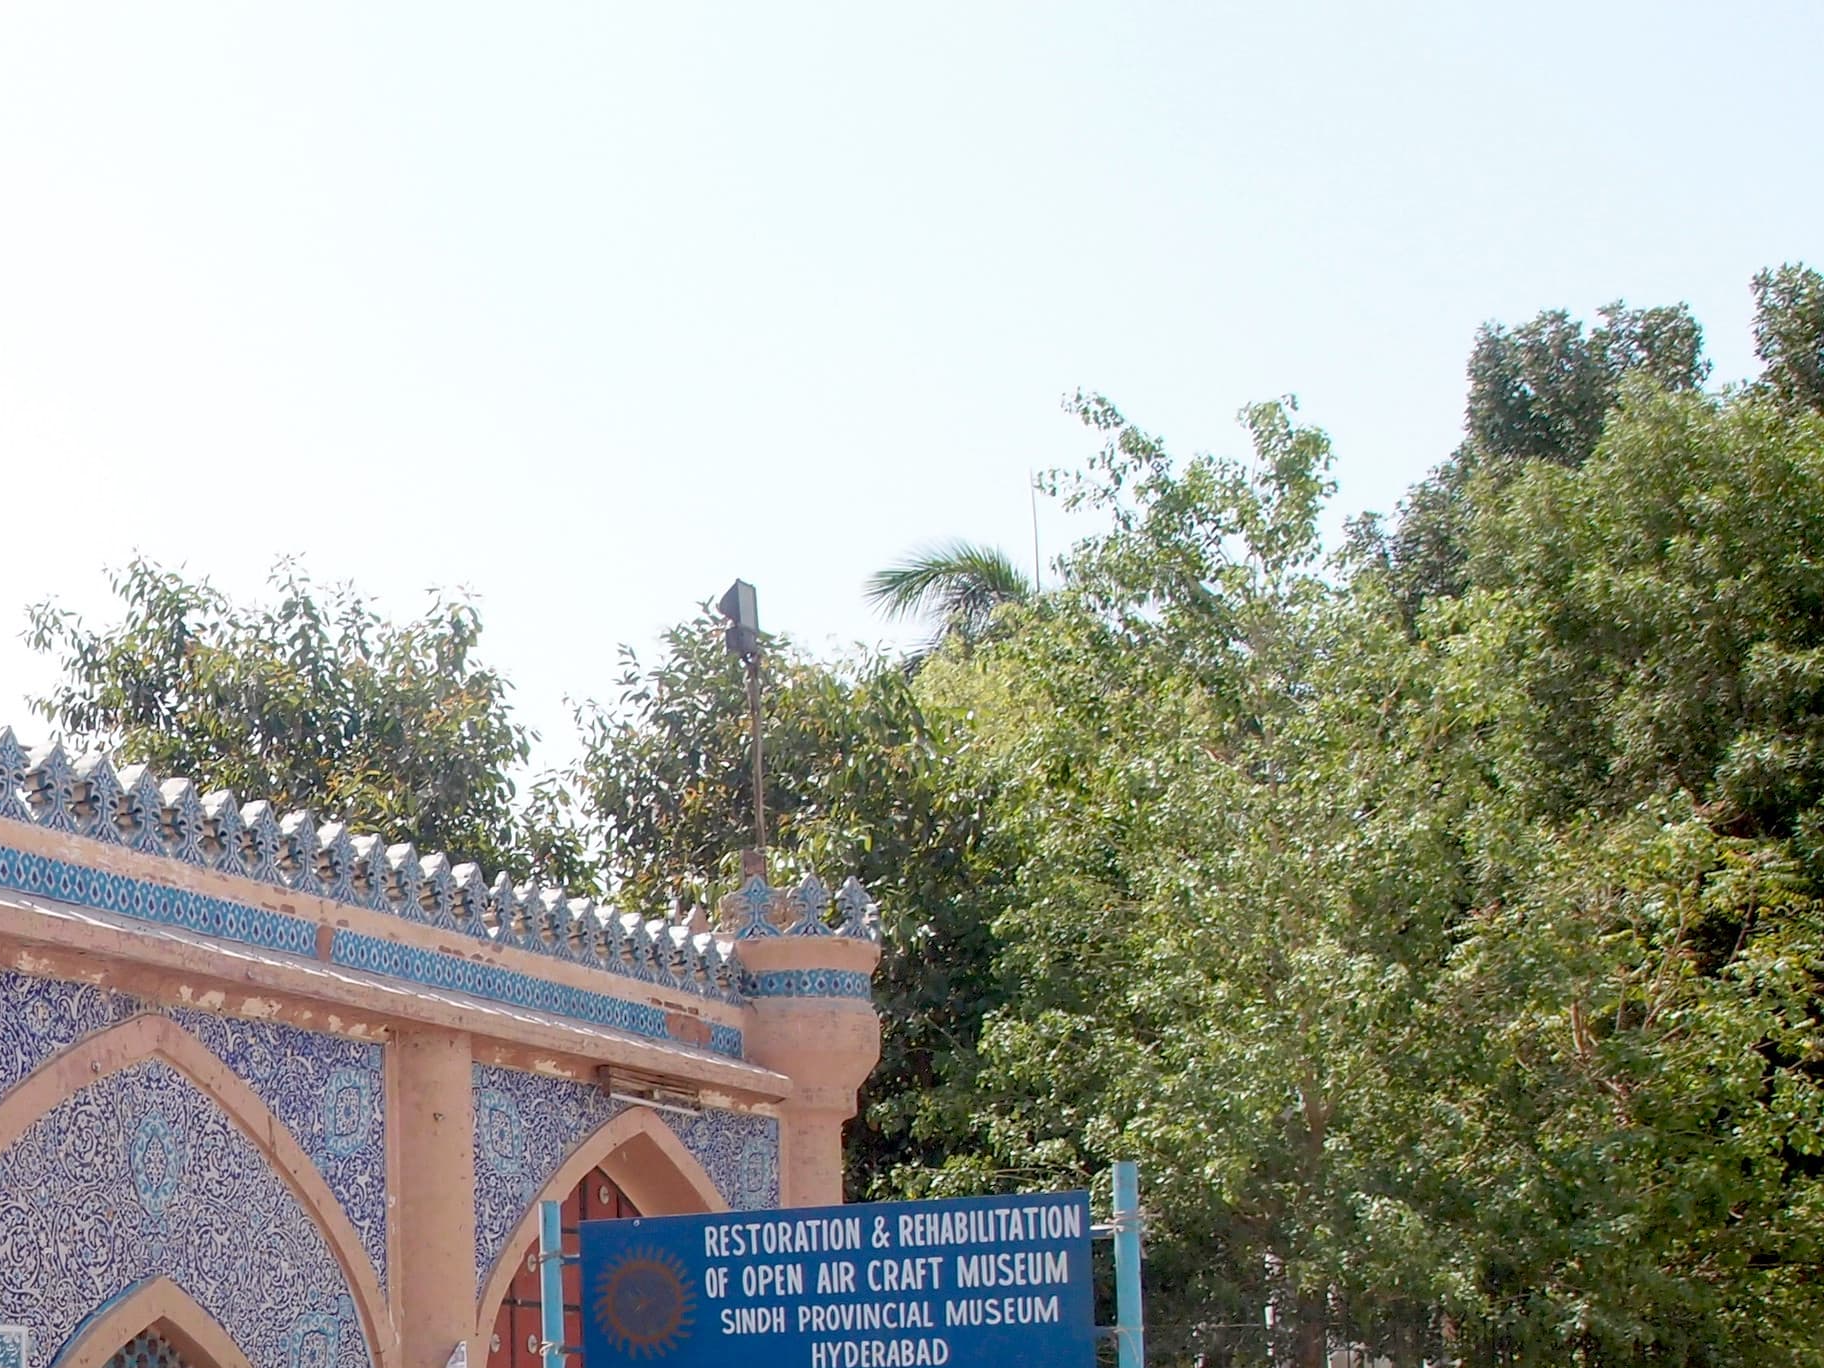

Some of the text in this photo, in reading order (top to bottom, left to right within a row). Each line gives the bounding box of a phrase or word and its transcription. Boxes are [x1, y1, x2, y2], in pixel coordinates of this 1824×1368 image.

[704, 1204, 1080, 1257] RESTORATION & REHABILITATION
[705, 1250, 1069, 1298] OF OPEN AIR CRAFT MUSEUM
[720, 1295, 1059, 1335] SINDH PROVINCIAL MUSEUM
